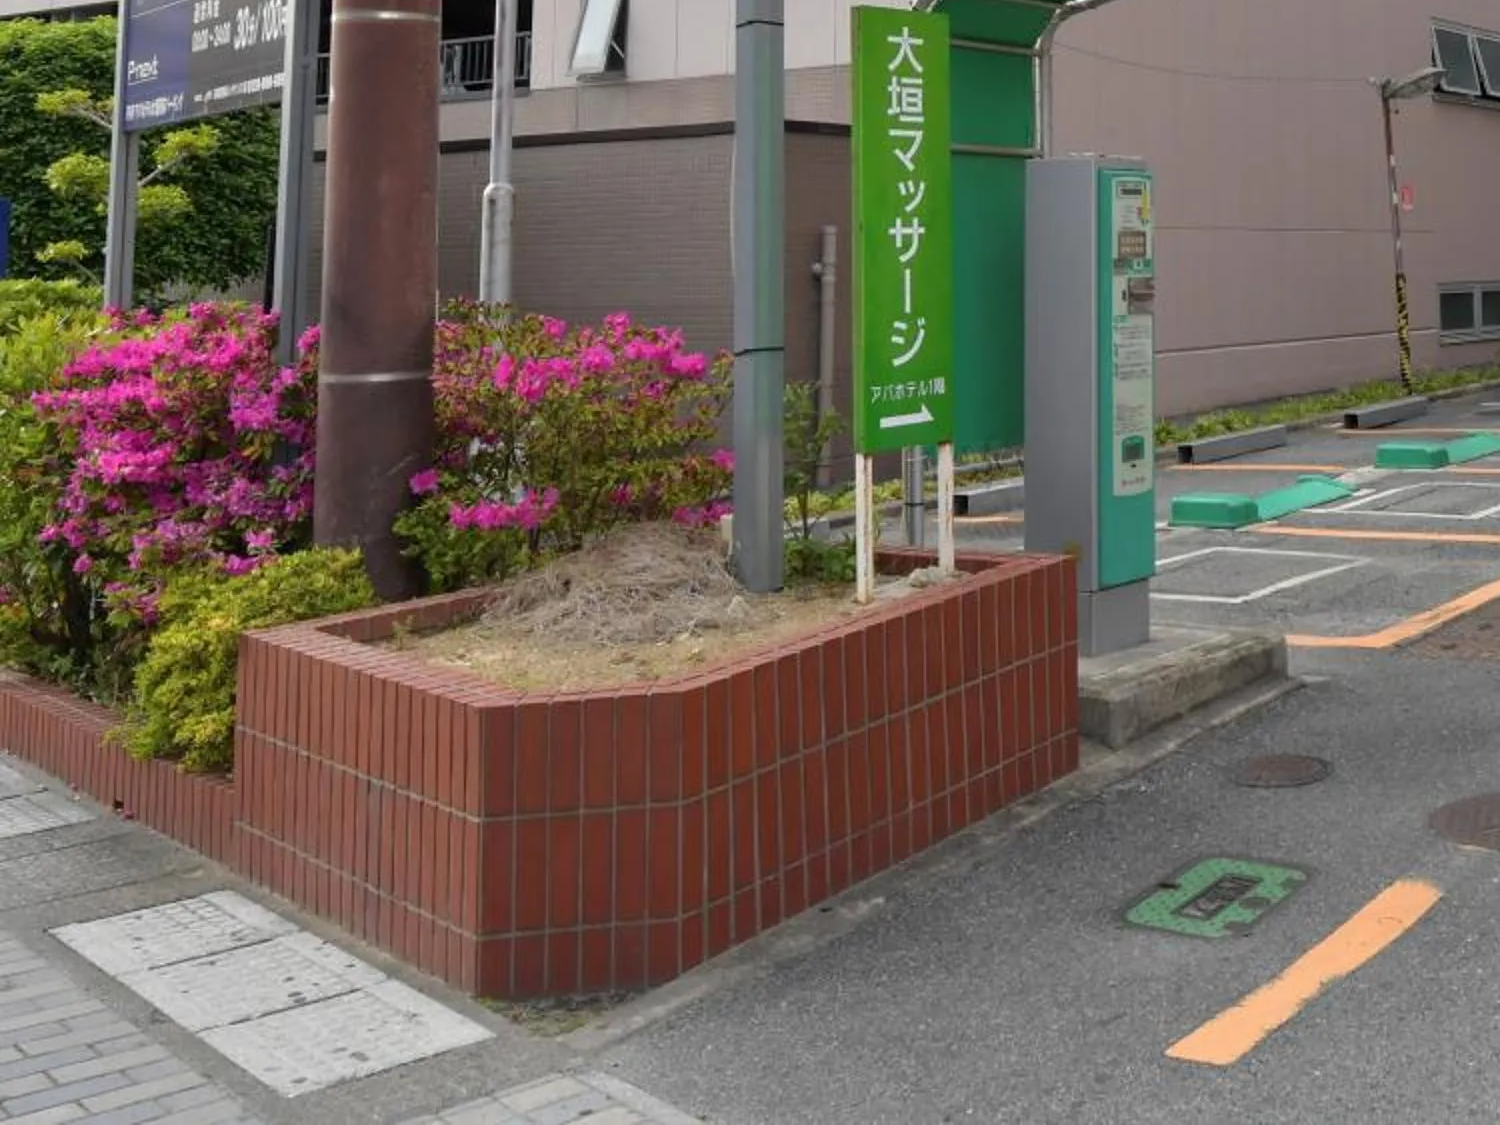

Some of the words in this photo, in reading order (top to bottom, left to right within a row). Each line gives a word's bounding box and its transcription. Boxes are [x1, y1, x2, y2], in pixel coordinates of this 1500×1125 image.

[886, 26, 927, 368] 大垣マッサージ
